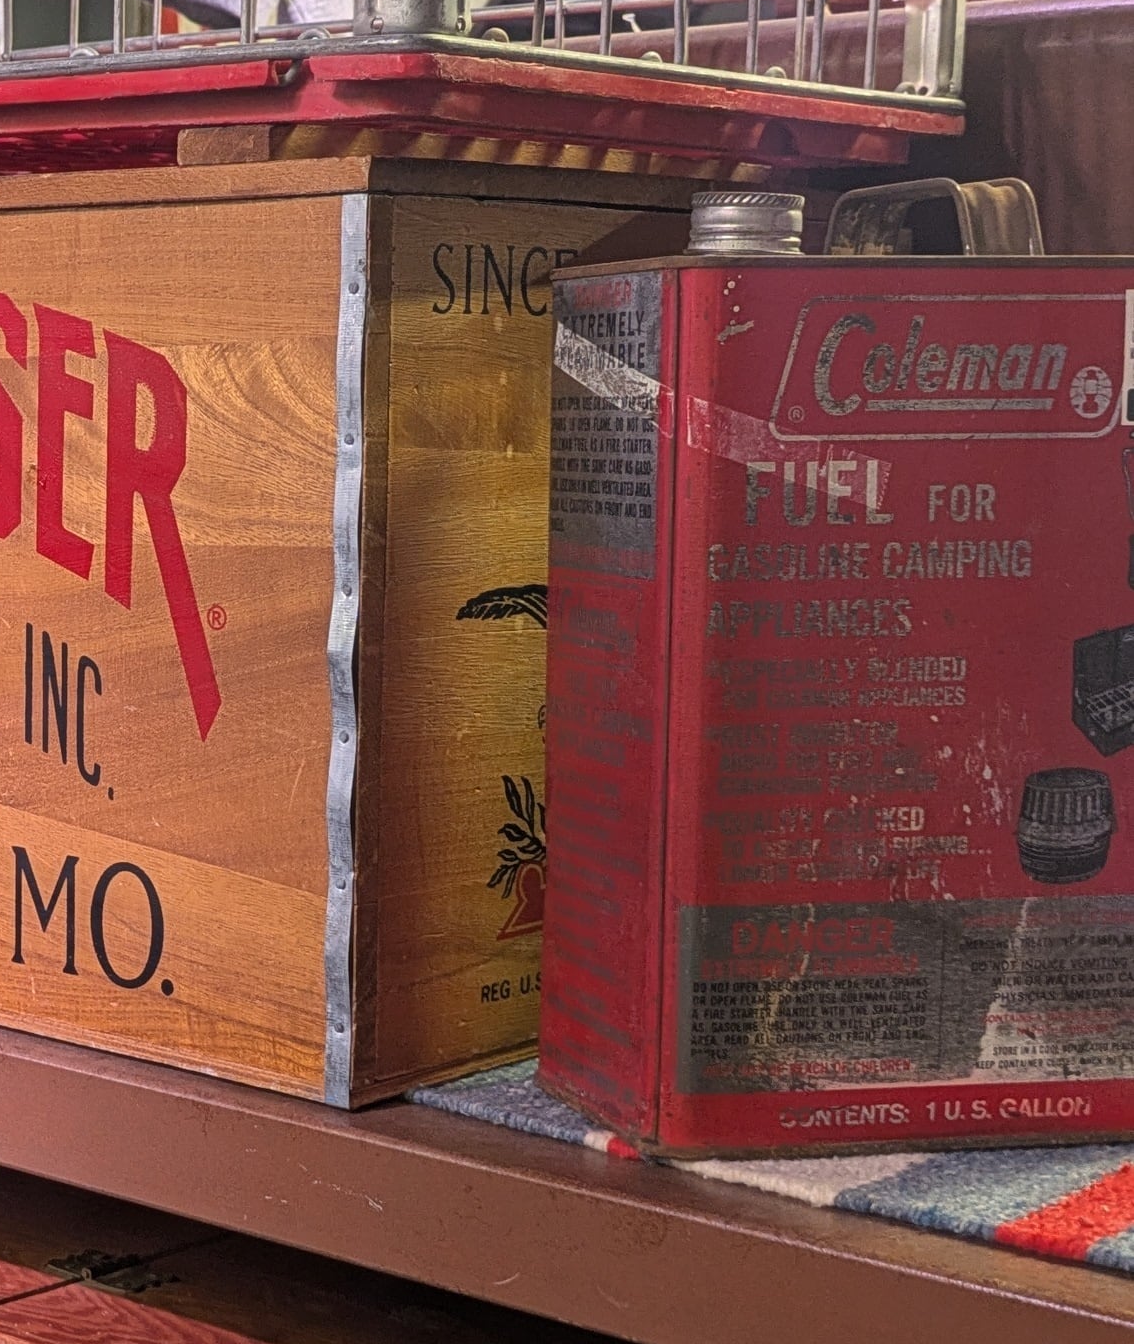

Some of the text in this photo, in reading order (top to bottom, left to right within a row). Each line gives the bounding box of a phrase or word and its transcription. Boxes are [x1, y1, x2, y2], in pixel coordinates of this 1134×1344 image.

[432, 242, 579, 317] SINC
[563, 310, 645, 338] EXTREMELY
[814, 313, 1067, 416] Coleman
[745, 459, 997, 526] FUEL FOR
[707, 539, 1032, 582] GASOLINE CAMPING
[704, 598, 914, 638] APPLIANCES
[25, 621, 114, 801] INC.
[12, 846, 175, 997] MO.
[732, 916, 895, 956] DANGER
[779, 1104, 910, 1128] CONTENTS:
[926, 1102, 936, 1122] 1
[999, 1096, 1092, 1120] GALLON
